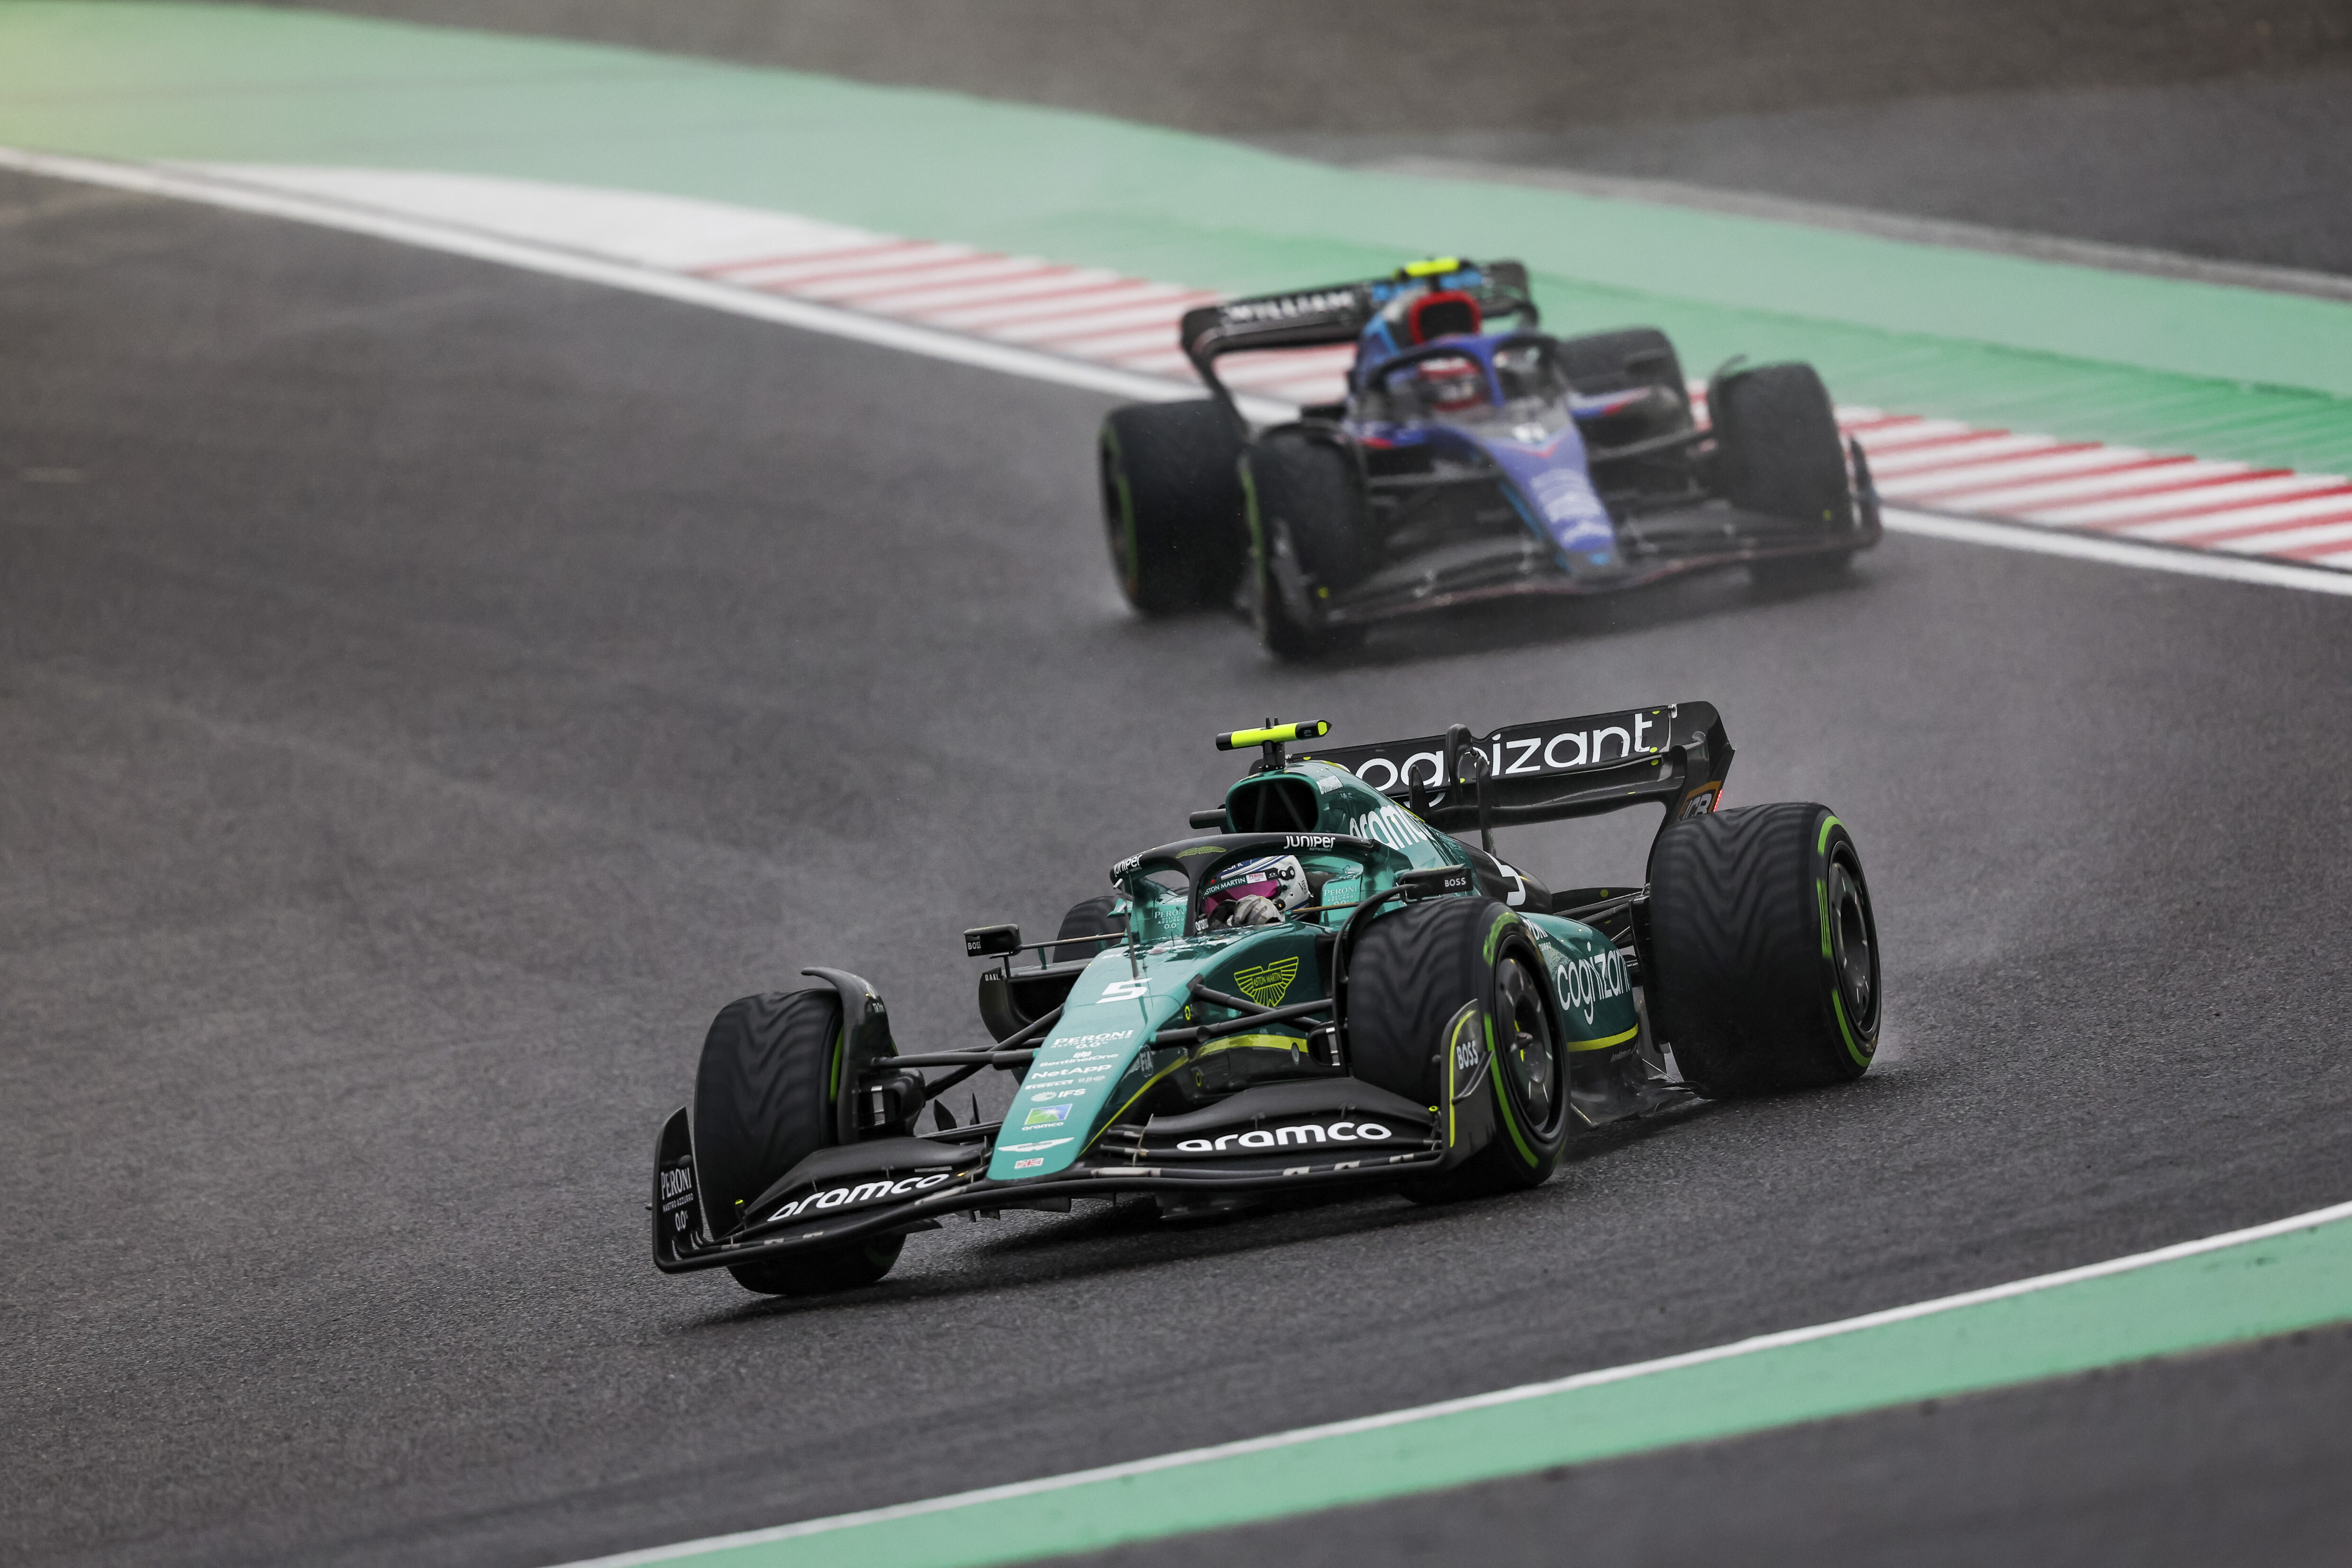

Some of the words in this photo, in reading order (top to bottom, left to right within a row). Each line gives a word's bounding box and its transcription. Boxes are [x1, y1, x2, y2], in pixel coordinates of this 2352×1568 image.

[1335, 713, 1653, 807] ogizant
[1221, 877, 1246, 889] MARTIN
[1445, 877, 1466, 887] BOSS
[1324, 886, 1357, 896] PERONI
[1155, 908, 1185, 919] PERON
[967, 941, 981, 950] BOSS
[1096, 977, 1153, 1004] 5
[1557, 942, 1630, 1025] cognizan
[1052, 1029, 1134, 1046] PERONI
[1456, 1040, 1479, 1070] BOSS
[1031, 1064, 1112, 1079] NetApp
[1058, 1088, 1087, 1098] IFS
[1021, 1122, 1064, 1131] aramco
[1176, 1122, 1392, 1152] aramco
[660, 1167, 692, 1200] PERONI
[767, 1174, 950, 1222] aramco
